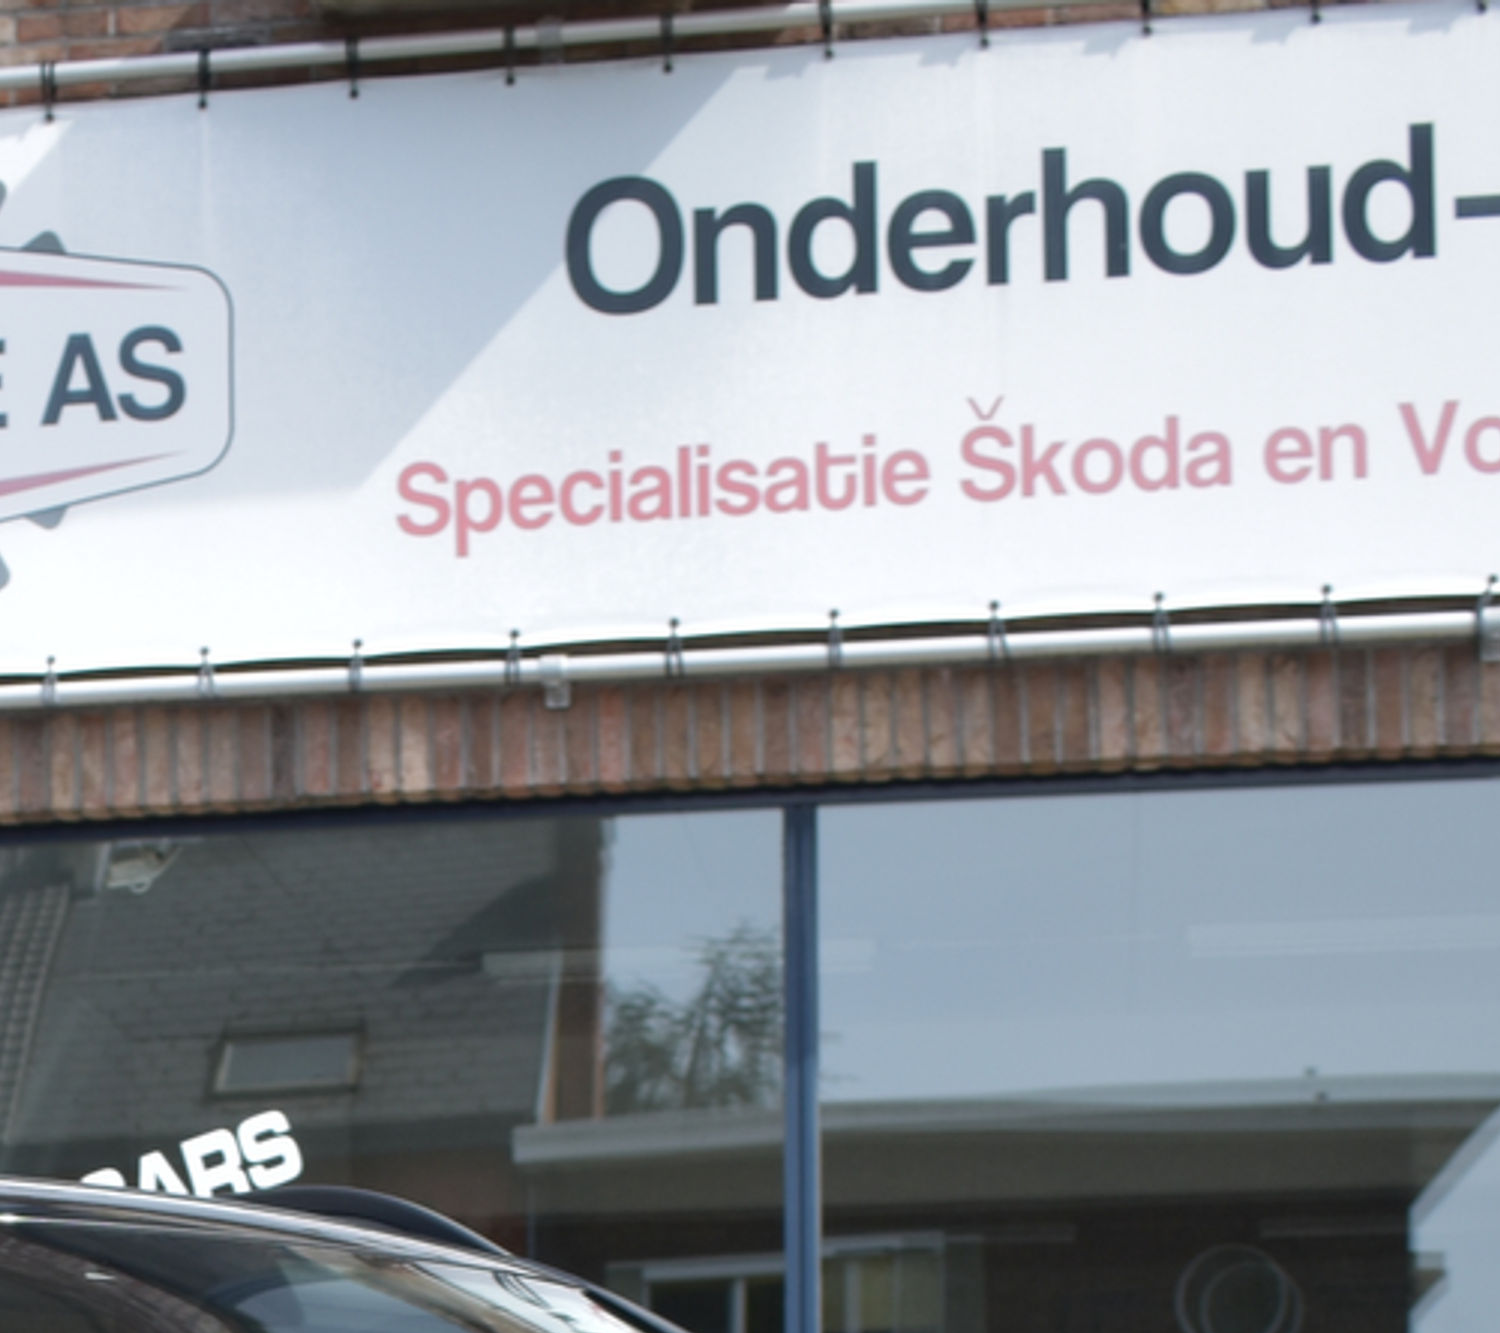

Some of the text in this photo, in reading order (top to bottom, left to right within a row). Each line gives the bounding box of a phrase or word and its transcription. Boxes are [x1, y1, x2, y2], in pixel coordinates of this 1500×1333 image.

[41, 325, 186, 426] AS
[396, 442, 931, 559] Specialisatie
[960, 396, 1233, 503] Škoda
[1263, 424, 1368, 485] en
